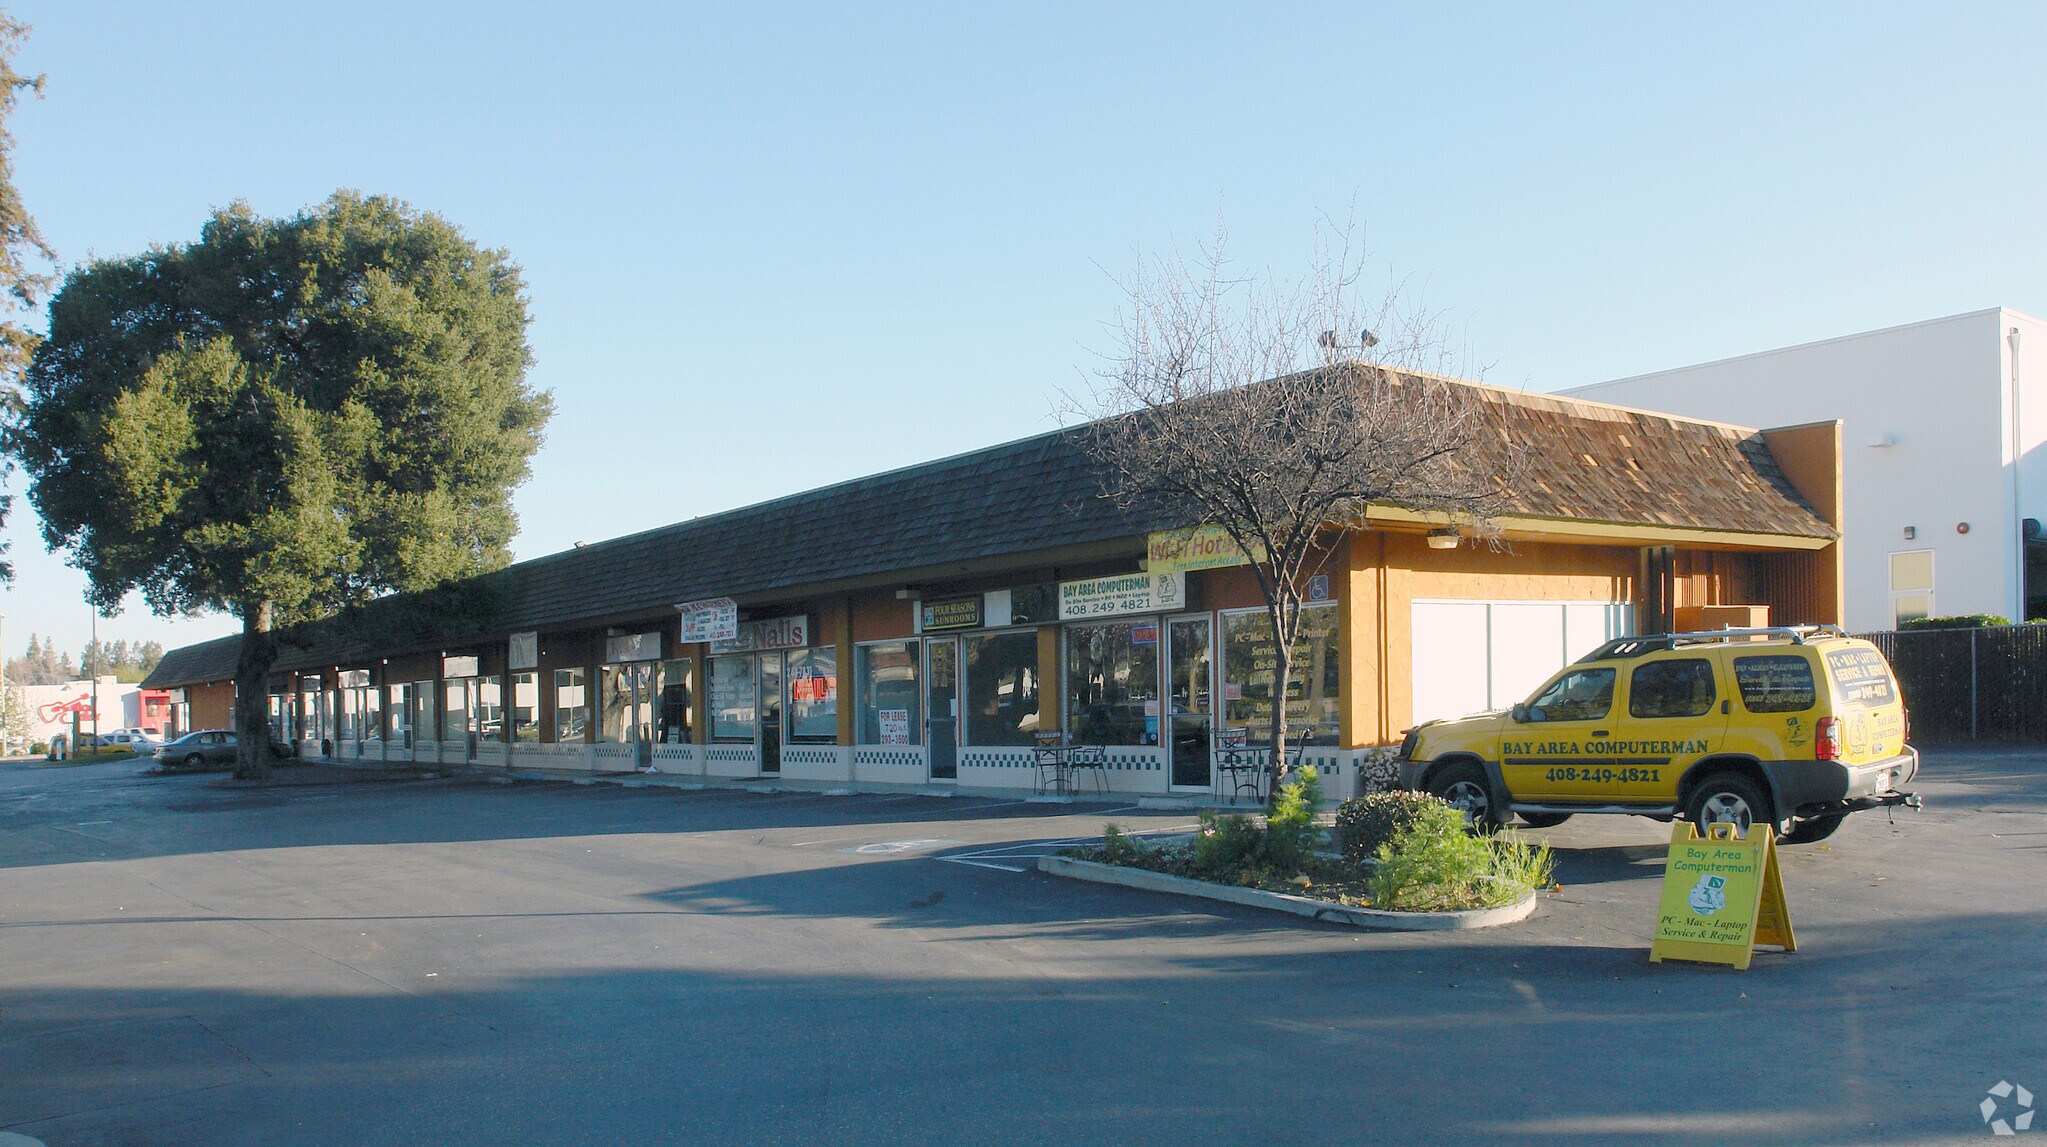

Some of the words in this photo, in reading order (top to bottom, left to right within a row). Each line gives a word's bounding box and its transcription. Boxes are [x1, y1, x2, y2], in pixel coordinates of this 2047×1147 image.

[1063, 584, 1077, 598] BAY
[1078, 582, 1096, 596] AREA
[1097, 576, 1151, 594] COMPUTERMAN
[935, 605, 950, 616] FOUR
[950, 602, 976, 615] SEASONS
[935, 613, 976, 625] SUNROOMS
[752, 619, 803, 650] Nails
[1302, 628, 1330, 639] Printer
[1251, 645, 1278, 656] Servic
[1290, 643, 1313, 655] epair
[881, 711, 890, 721] FOR
[891, 711, 906, 721] LEASE
[1503, 741, 1533, 755] BAY
[1537, 741, 1580, 755] AREA
[1585, 740, 1709, 754] COMPUTERMAN
[1545, 767, 1661, 783] 408-249-4821
[1687, 847, 1708, 861] Bay
[1714, 849, 1742, 860] Area
[1674, 861, 1751, 873] Computerman
[1661, 915, 1676, 925] PC
[1684, 917, 1704, 927] Mac
[1714, 920, 1748, 930] Laptop
[1661, 927, 1696, 938] Service
[1709, 930, 1743, 942] Repair
